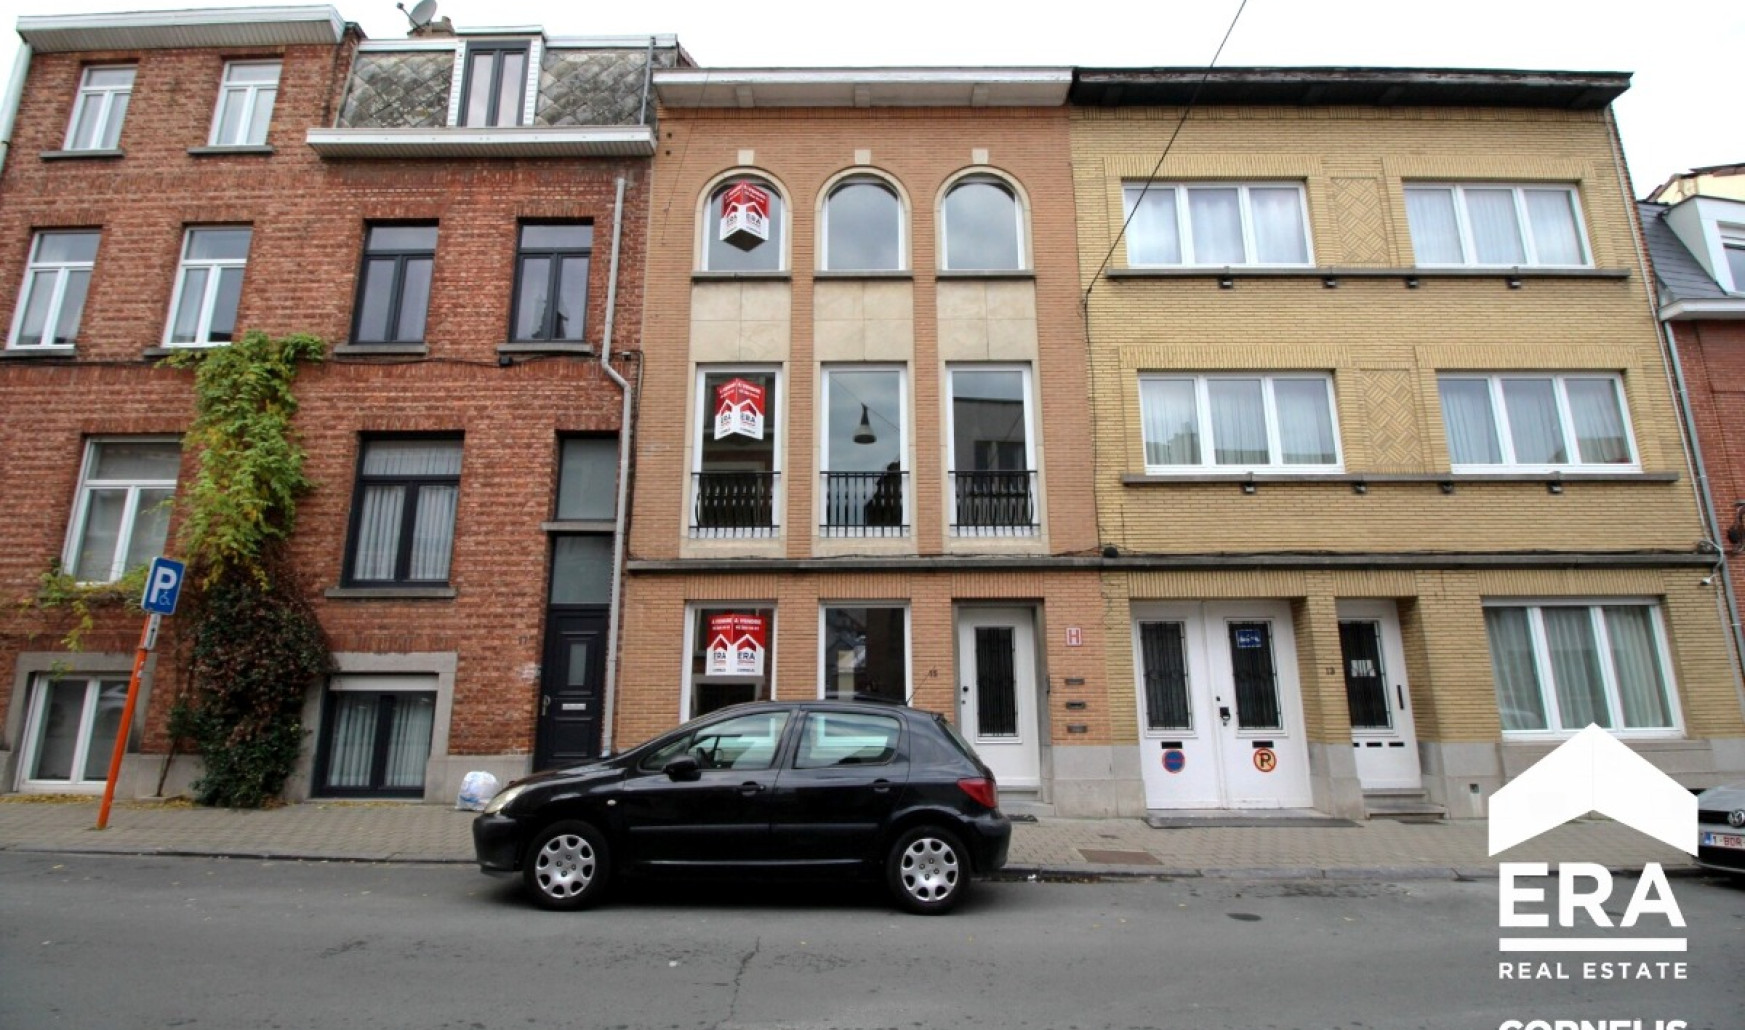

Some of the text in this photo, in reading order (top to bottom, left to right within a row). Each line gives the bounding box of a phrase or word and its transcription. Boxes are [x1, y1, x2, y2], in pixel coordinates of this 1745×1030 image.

[148, 566, 177, 603] P
[1069, 629, 1081, 644] H
[737, 652, 756, 660] ERA
